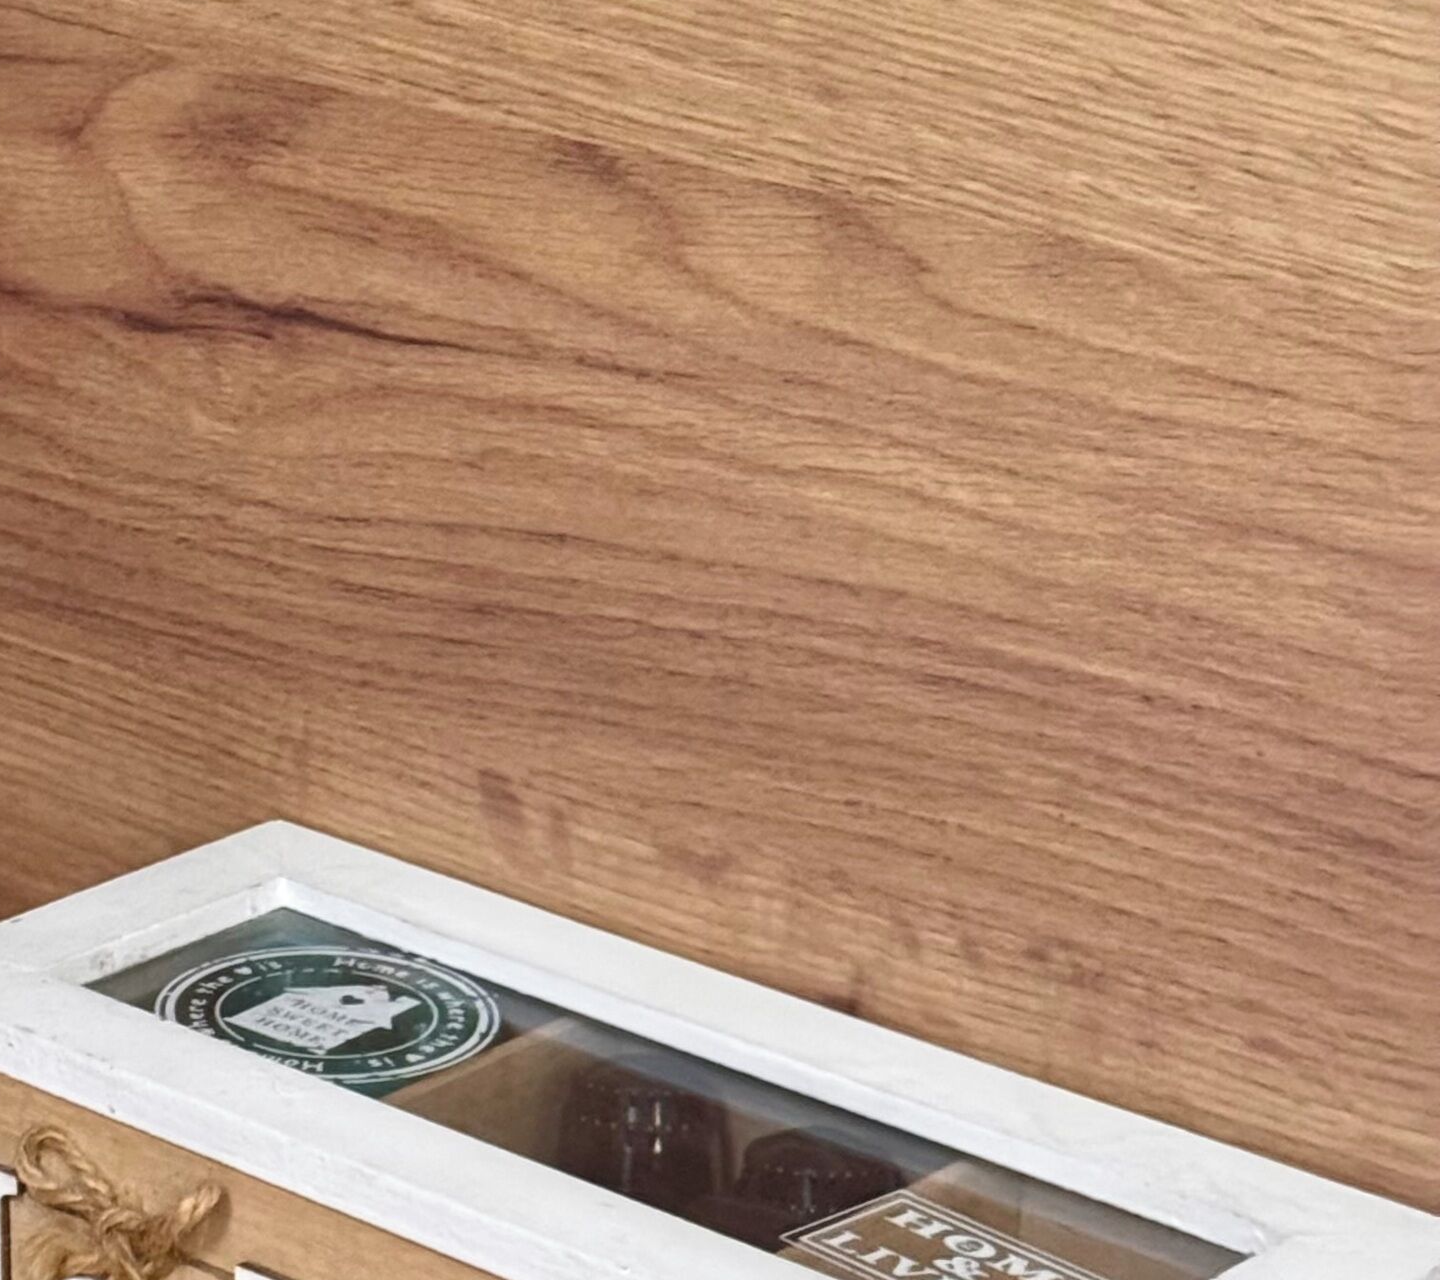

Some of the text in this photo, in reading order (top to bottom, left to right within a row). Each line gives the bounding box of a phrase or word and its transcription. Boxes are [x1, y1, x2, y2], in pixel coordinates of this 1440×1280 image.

[333, 956, 410, 978] Home
[435, 991, 467, 1030] where
[268, 1006, 349, 1037] SWEET
[289, 998, 375, 1025] HOME
[255, 1017, 327, 1042] HOME
[931, 1255, 990, 1280] &
